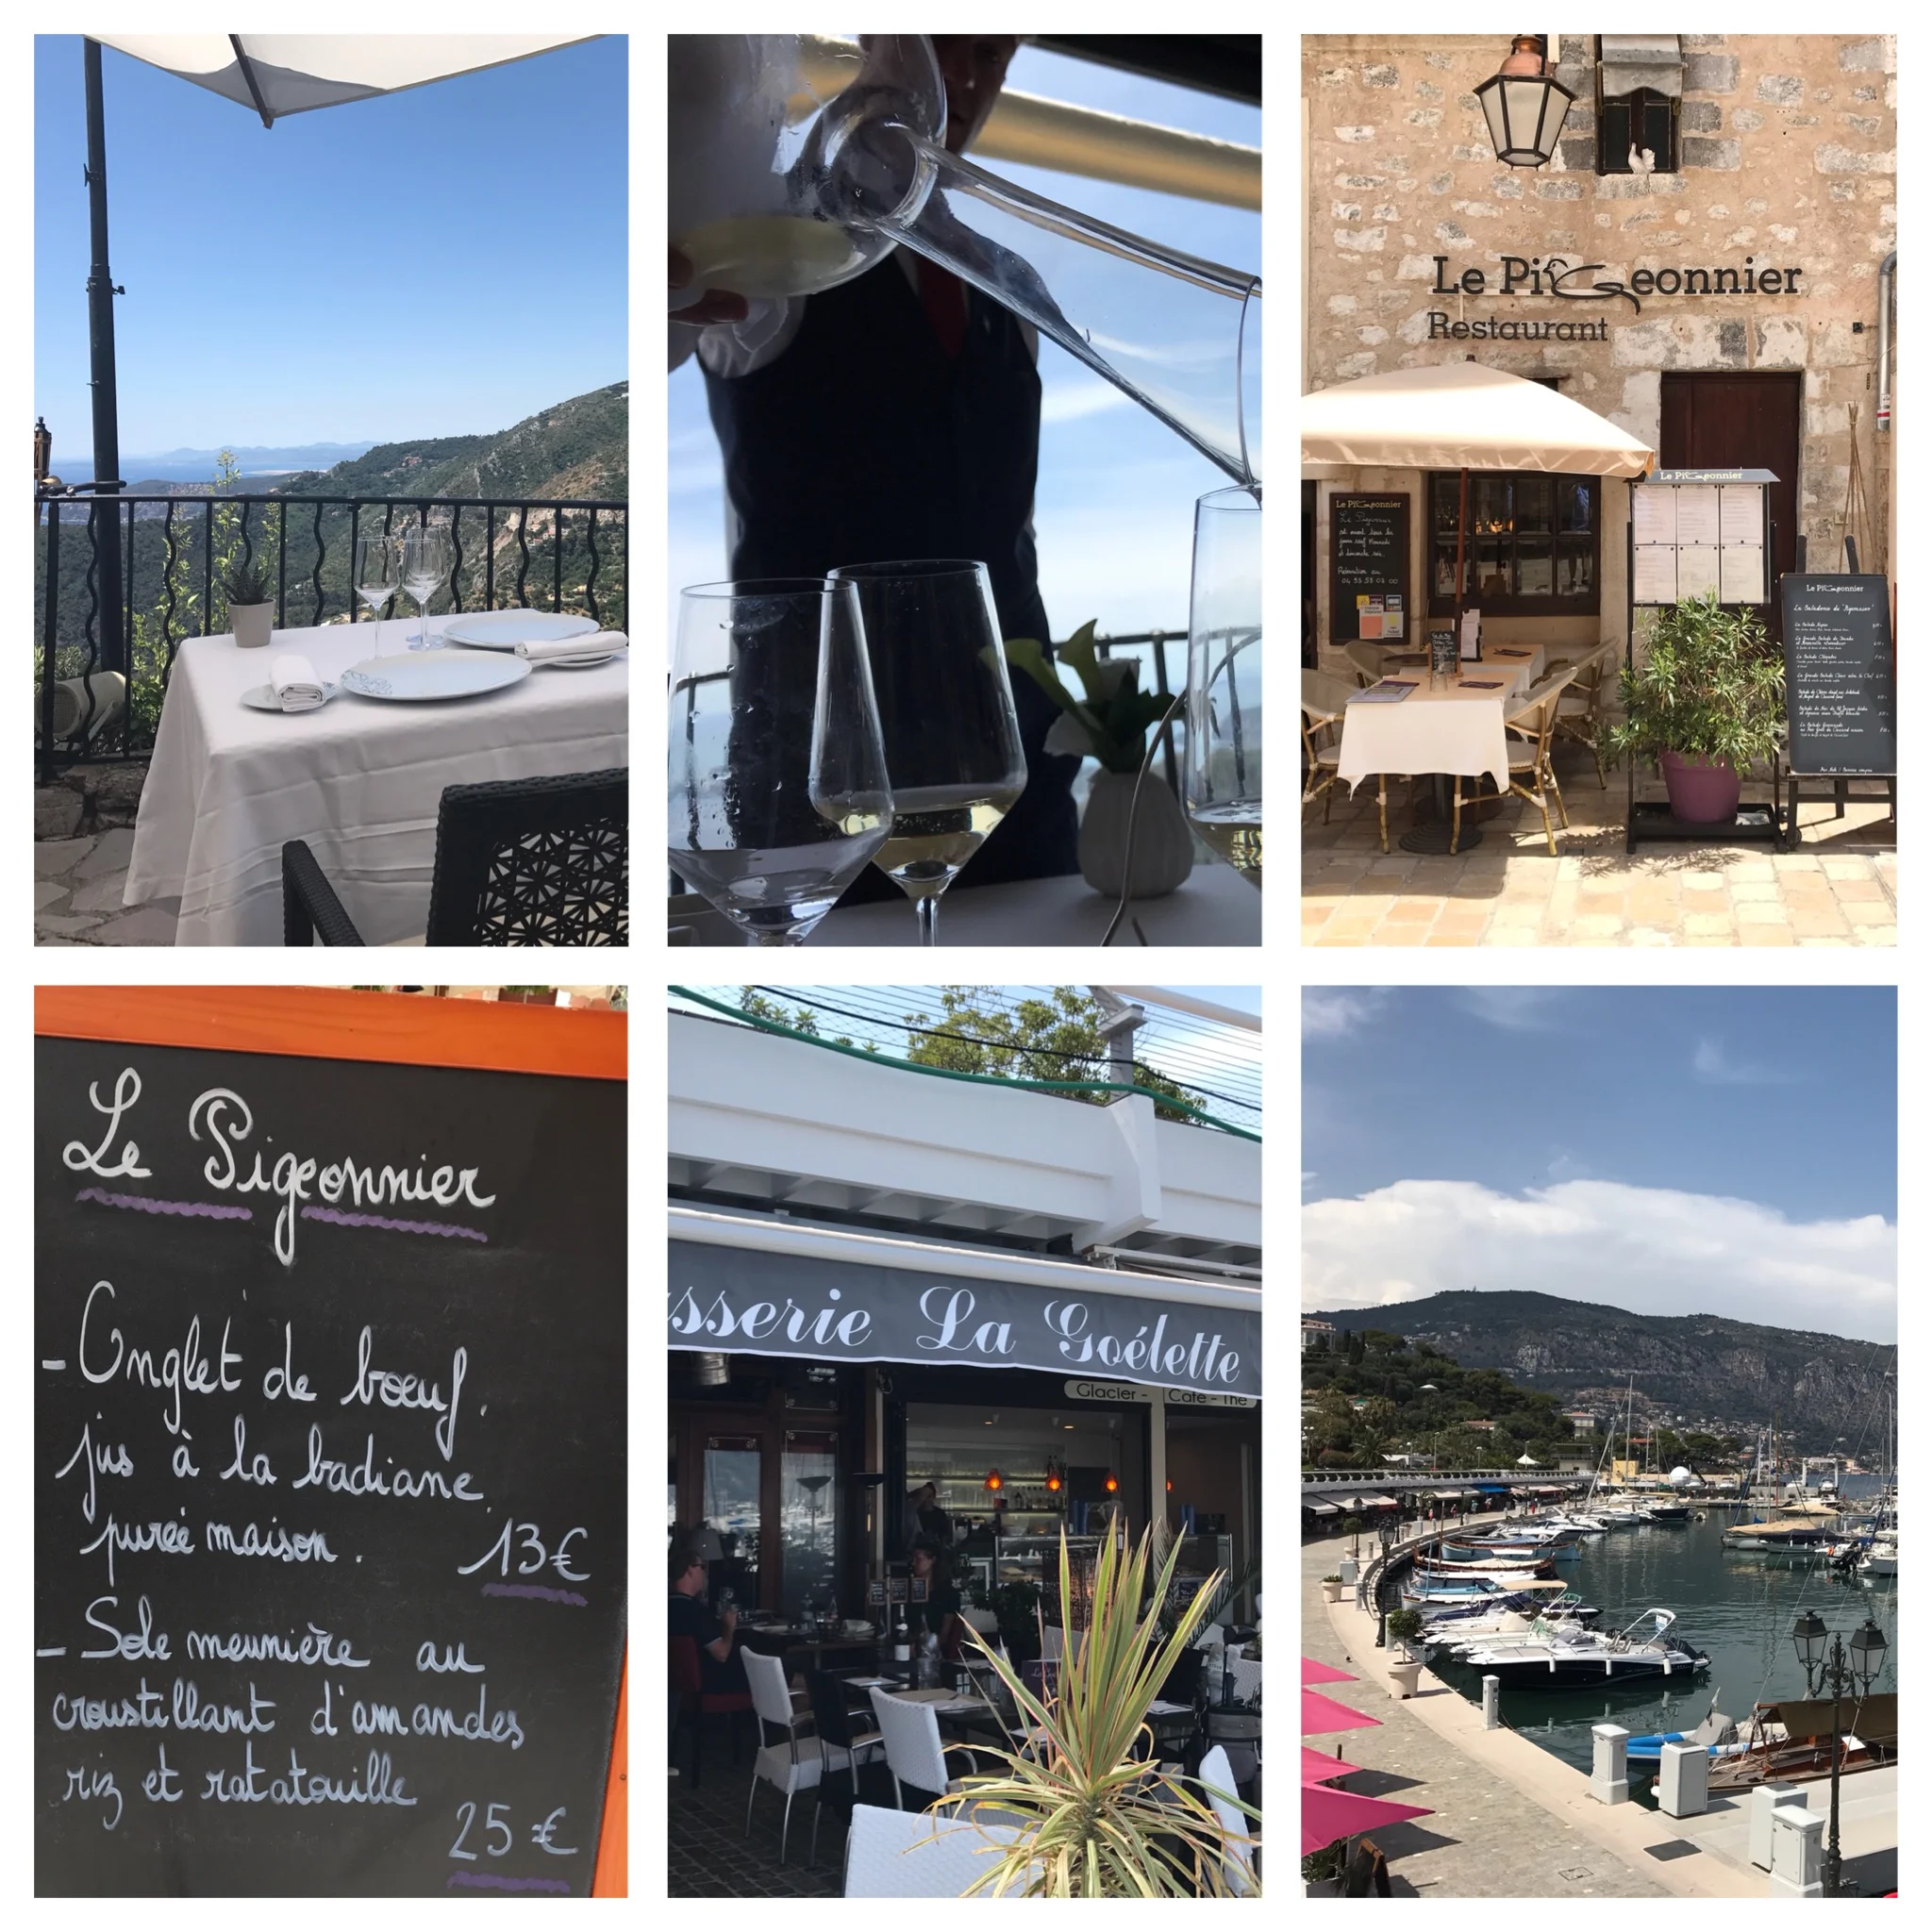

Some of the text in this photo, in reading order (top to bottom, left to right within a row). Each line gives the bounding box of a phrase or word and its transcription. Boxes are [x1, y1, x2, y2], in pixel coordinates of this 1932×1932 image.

[1432, 257, 1485, 293] Le
[1426, 311, 1608, 341] Restaurant
[1659, 470, 1672, 479] Le
[62, 1067, 497, 1266] Le Pigeonnier
[78, 1279, 244, 1434] Onglet
[263, 1321, 317, 1402] de
[668, 1286, 1241, 1384] sserie La Goélette
[1076, 1383, 1137, 1400] Glacier
[55, 1412, 134, 1524] jus
[173, 1430, 199, 1479] à
[221, 1415, 277, 1485] la
[80, 1507, 195, 1587] purée
[206, 1516, 339, 1564] maison
[81, 1595, 172, 1661] Sole
[188, 1622, 371, 1667] meunière
[415, 1641, 486, 1673] au
[52, 1677, 276, 1735] croustillant
[61, 1740, 419, 1831] riz et ratatouille
[447, 1803, 512, 1861] 25
